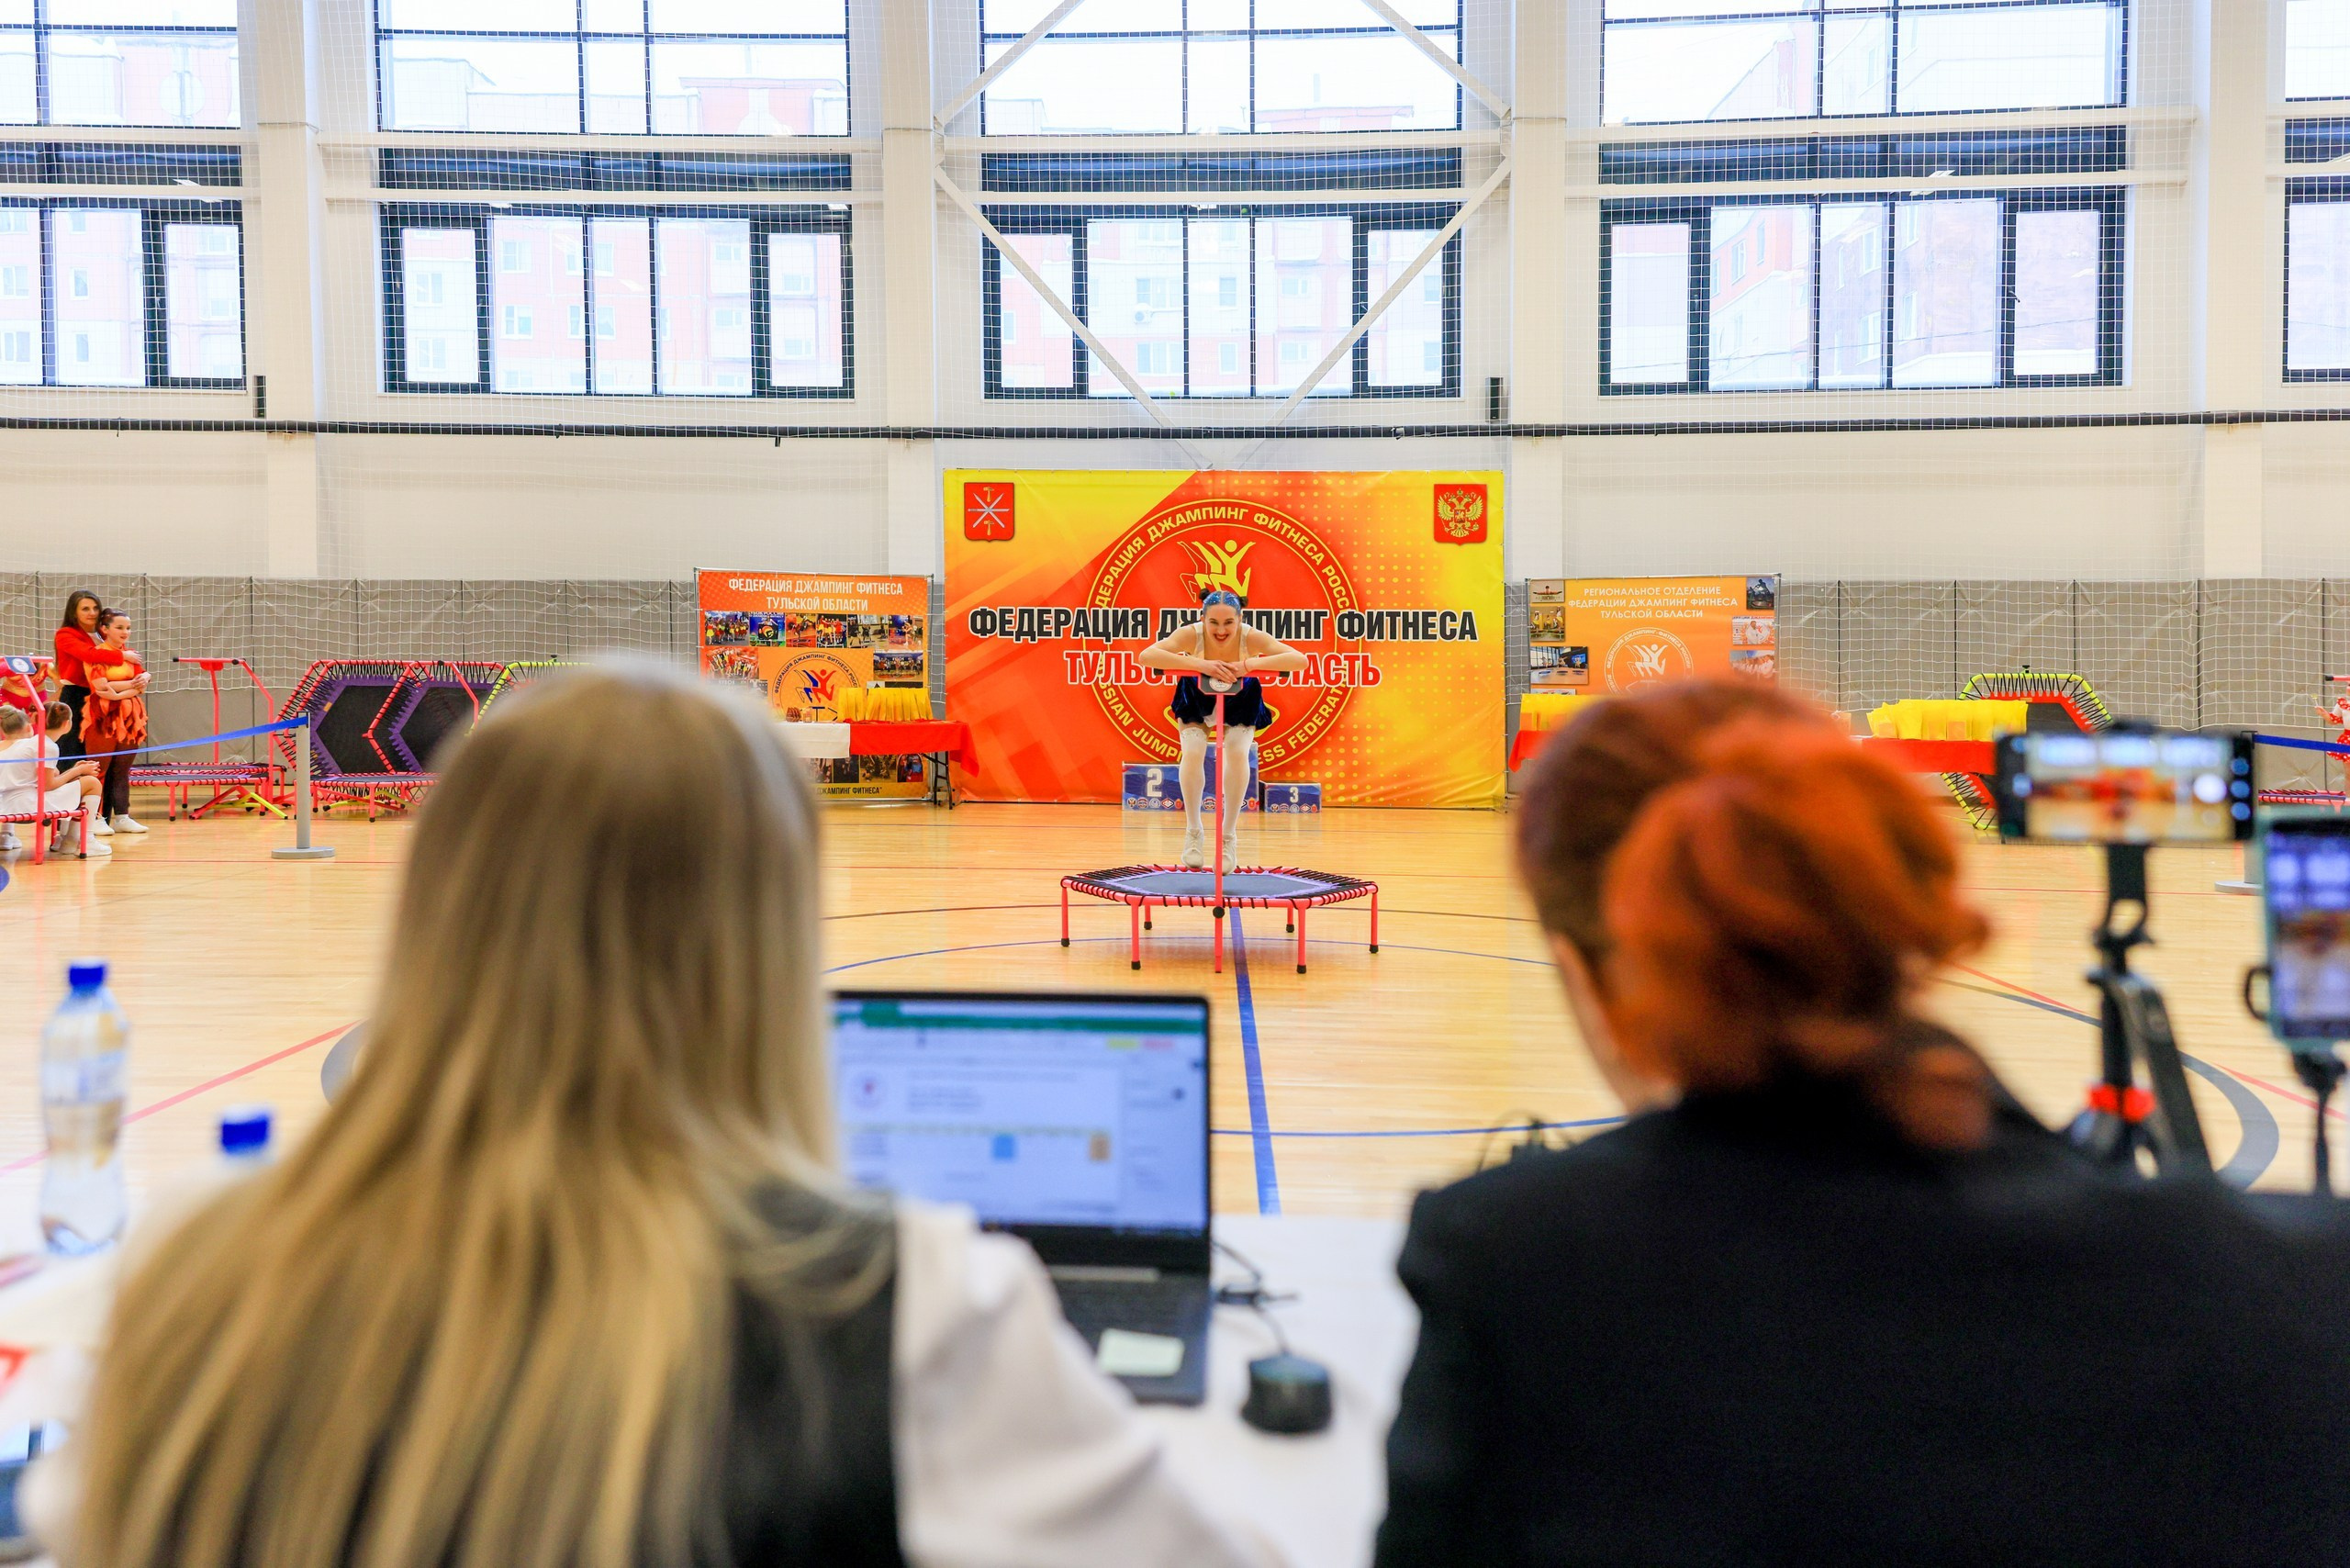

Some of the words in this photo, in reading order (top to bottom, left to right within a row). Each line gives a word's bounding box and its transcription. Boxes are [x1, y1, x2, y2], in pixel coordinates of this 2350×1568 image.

[1095, 536, 1146, 609] ДЕРАЦИЯ
[1147, 507, 1248, 543] ДЖАМПИНГ
[1253, 512, 1325, 566] ФИТНЕСА
[1322, 565, 1351, 612] РОСС
[729, 578, 792, 592] ФЕДЕРАЦИЯ
[795, 580, 854, 595] ДЖАМПИНГ
[856, 582, 903, 595] ФИТНЕСА
[1583, 588, 1660, 597] РЕГИОНАЛЬНОЕ
[1663, 586, 1721, 596] ОТДЕЛЕНИЕ
[767, 596, 820, 610] ТУЛЬСКОЙ
[822, 599, 868, 611] ОБЛАСТИ
[1568, 599, 1627, 609] ФЕДЕРАЦИИ
[1628, 599, 1687, 608] ДЖАМПИНГ
[1690, 598, 1738, 607] ФИТНЕСА
[1600, 608, 1652, 619] ТУЛЬСКОЙ
[1655, 610, 1704, 618] ОБЛАСТИ
[969, 607, 1149, 644] ФЕДЕРАЦИЯ
[1337, 610, 1478, 641] ФИТНЕСА
[774, 662, 793, 694] ФЕДЕРАЦИЯ
[793, 654, 826, 666] ДЖАМПИНГ
[826, 655, 850, 674] ФИТНЕСА
[848, 673, 858, 688] РОСС
[1147, 767, 1162, 798] 2
[1289, 786, 1299, 803] 3
